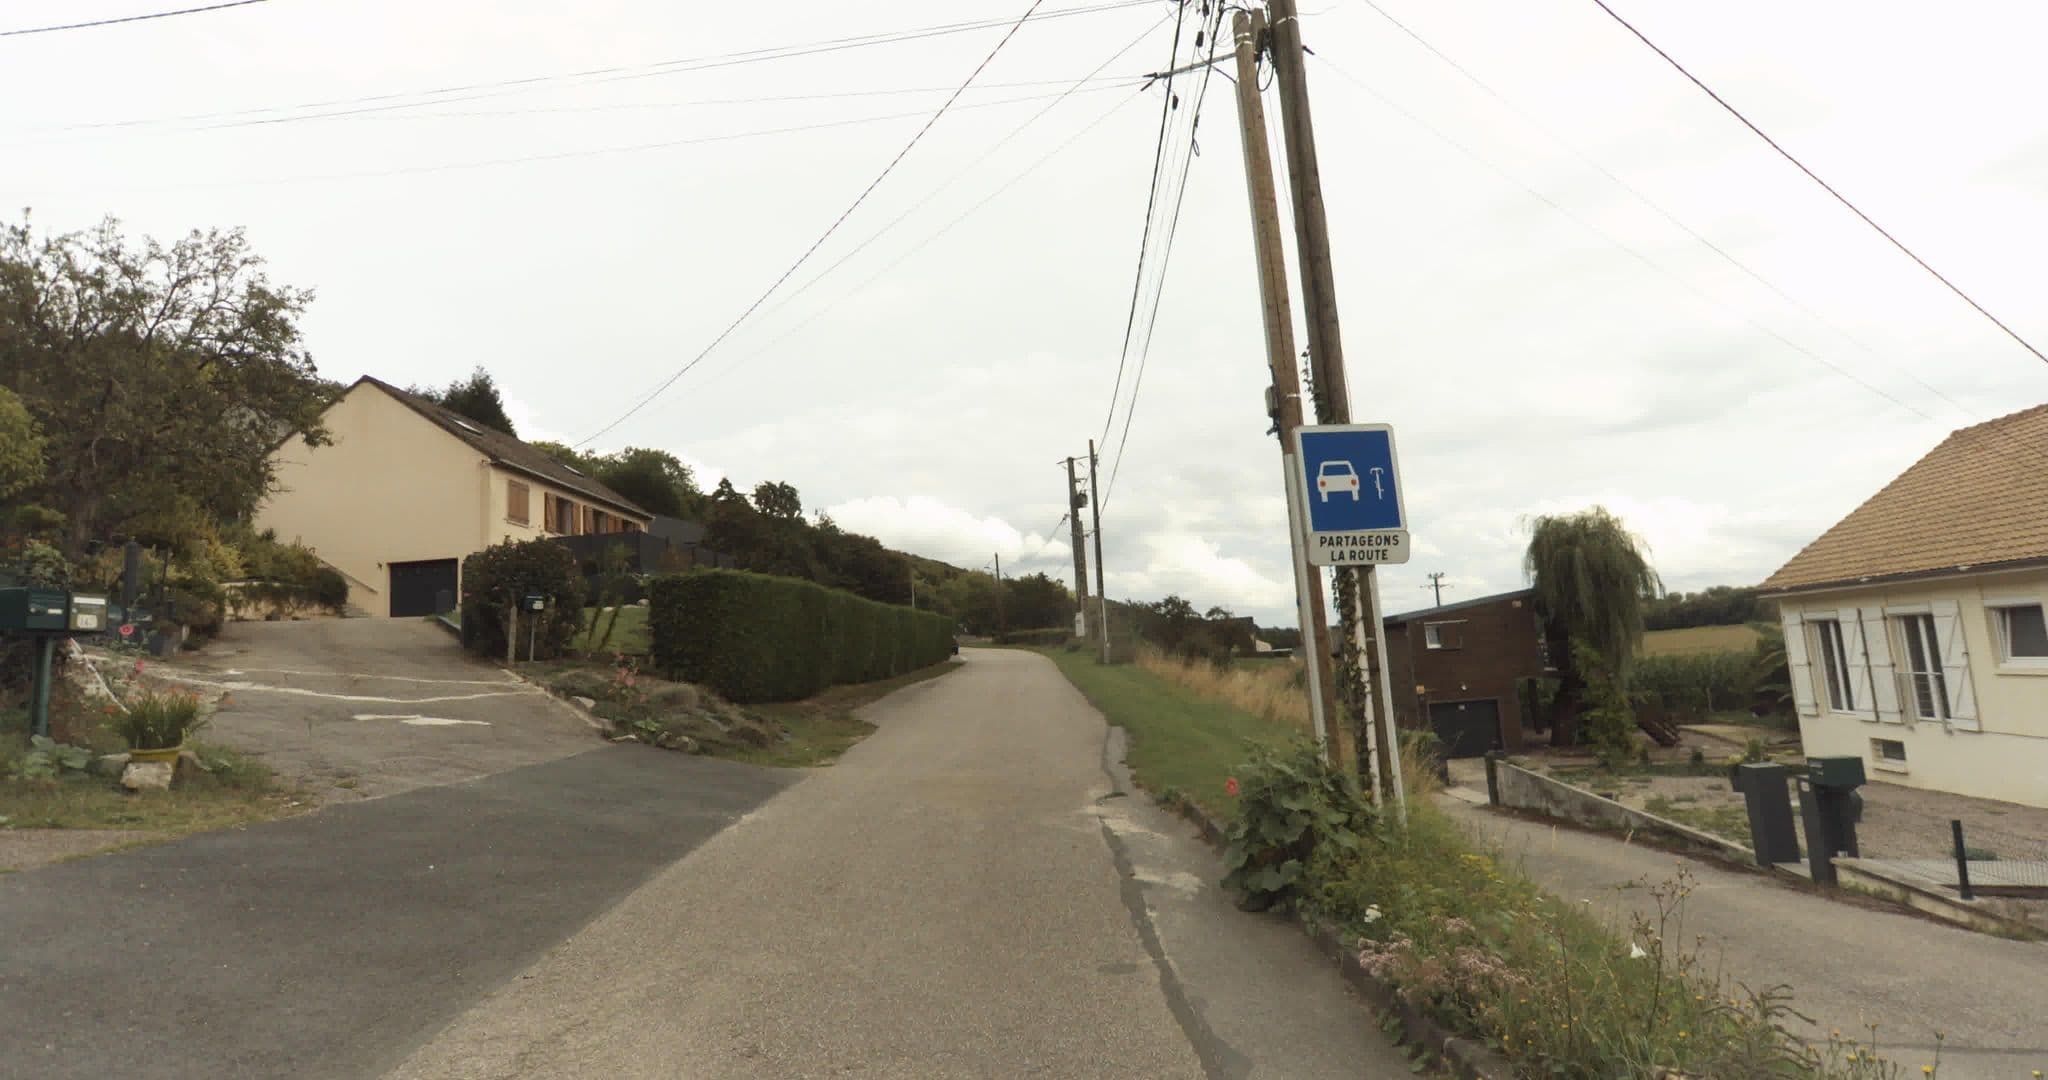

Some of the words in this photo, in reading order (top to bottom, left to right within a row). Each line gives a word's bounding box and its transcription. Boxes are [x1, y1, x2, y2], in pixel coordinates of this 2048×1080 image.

[1319, 535, 1400, 547] PARTAGEONS
[1331, 550, 1345, 561] LA
[1349, 549, 1388, 560] ROUTE
